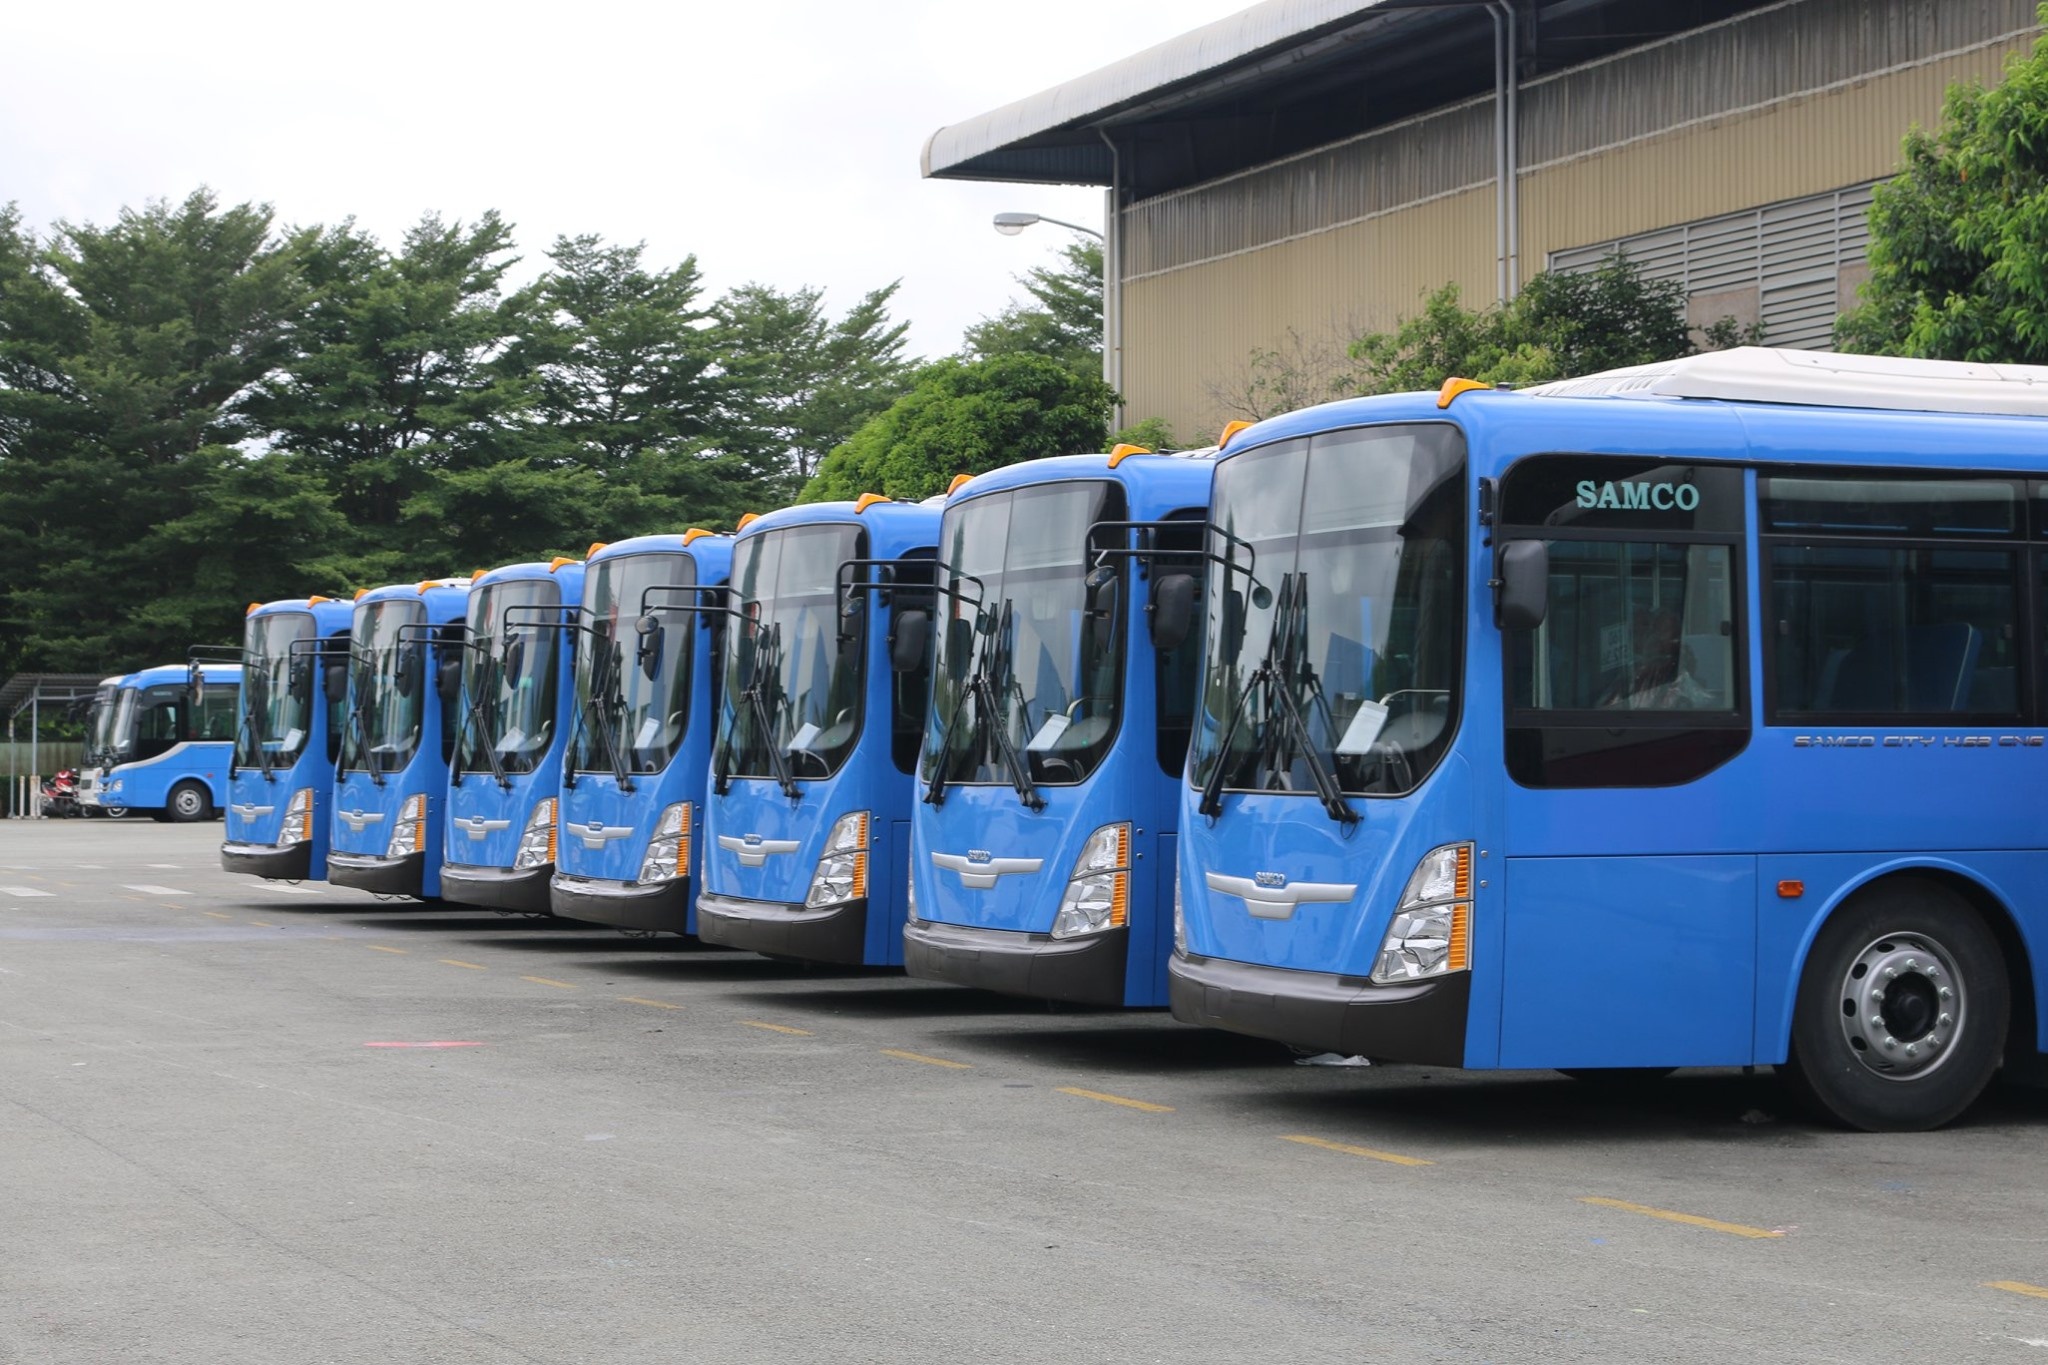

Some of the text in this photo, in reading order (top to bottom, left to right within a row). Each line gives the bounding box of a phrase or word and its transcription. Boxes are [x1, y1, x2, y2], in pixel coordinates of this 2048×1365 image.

[1576, 480, 1700, 511] SAMCO
[1793, 735, 1875, 747] SAMCO
[1883, 735, 1936, 747] CITY
[1998, 735, 2046, 747] CNG
